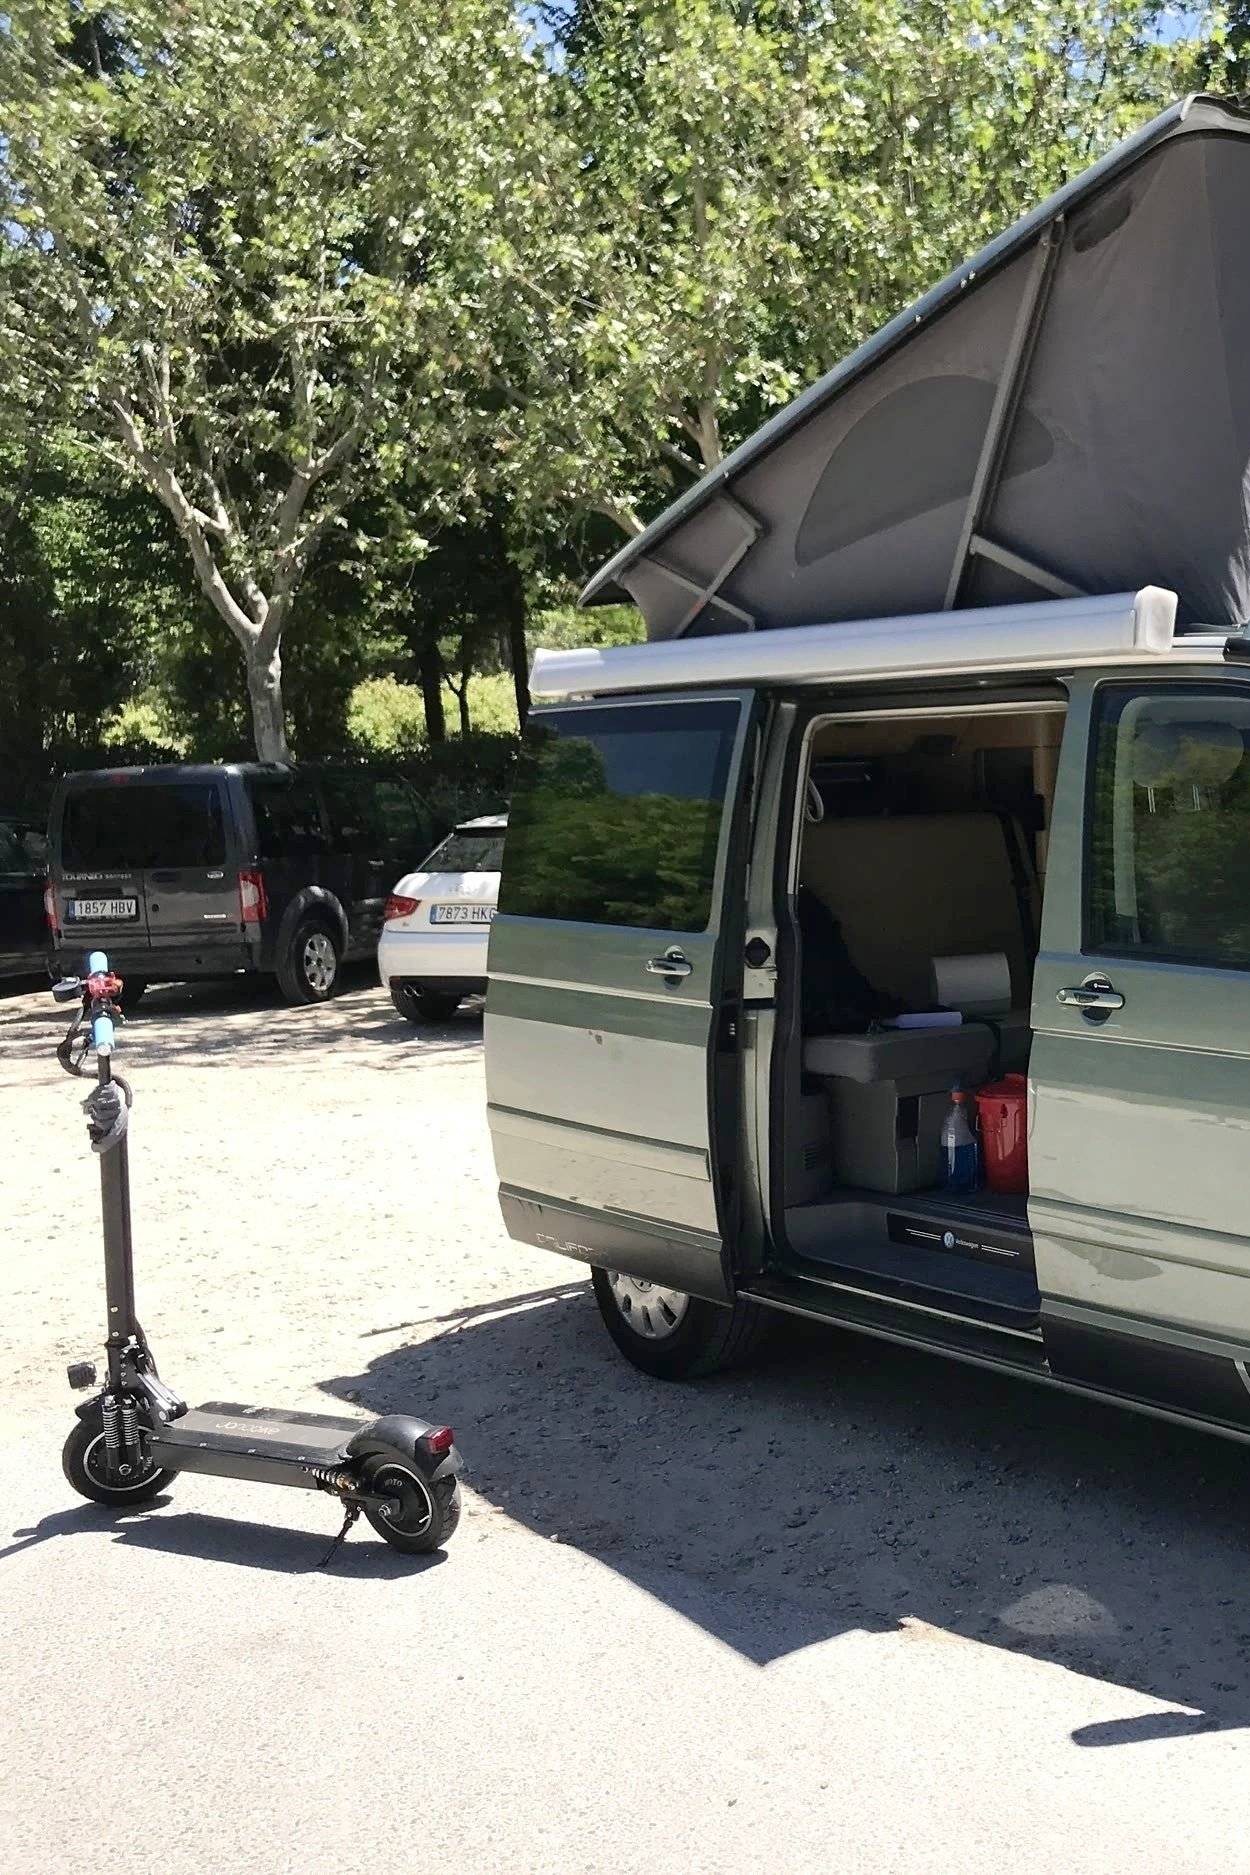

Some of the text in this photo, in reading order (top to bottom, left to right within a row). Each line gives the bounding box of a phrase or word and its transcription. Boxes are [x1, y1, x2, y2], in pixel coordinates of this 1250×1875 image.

[78, 901, 133, 915] 1857 HBV
[439, 907, 468, 920] 7873
